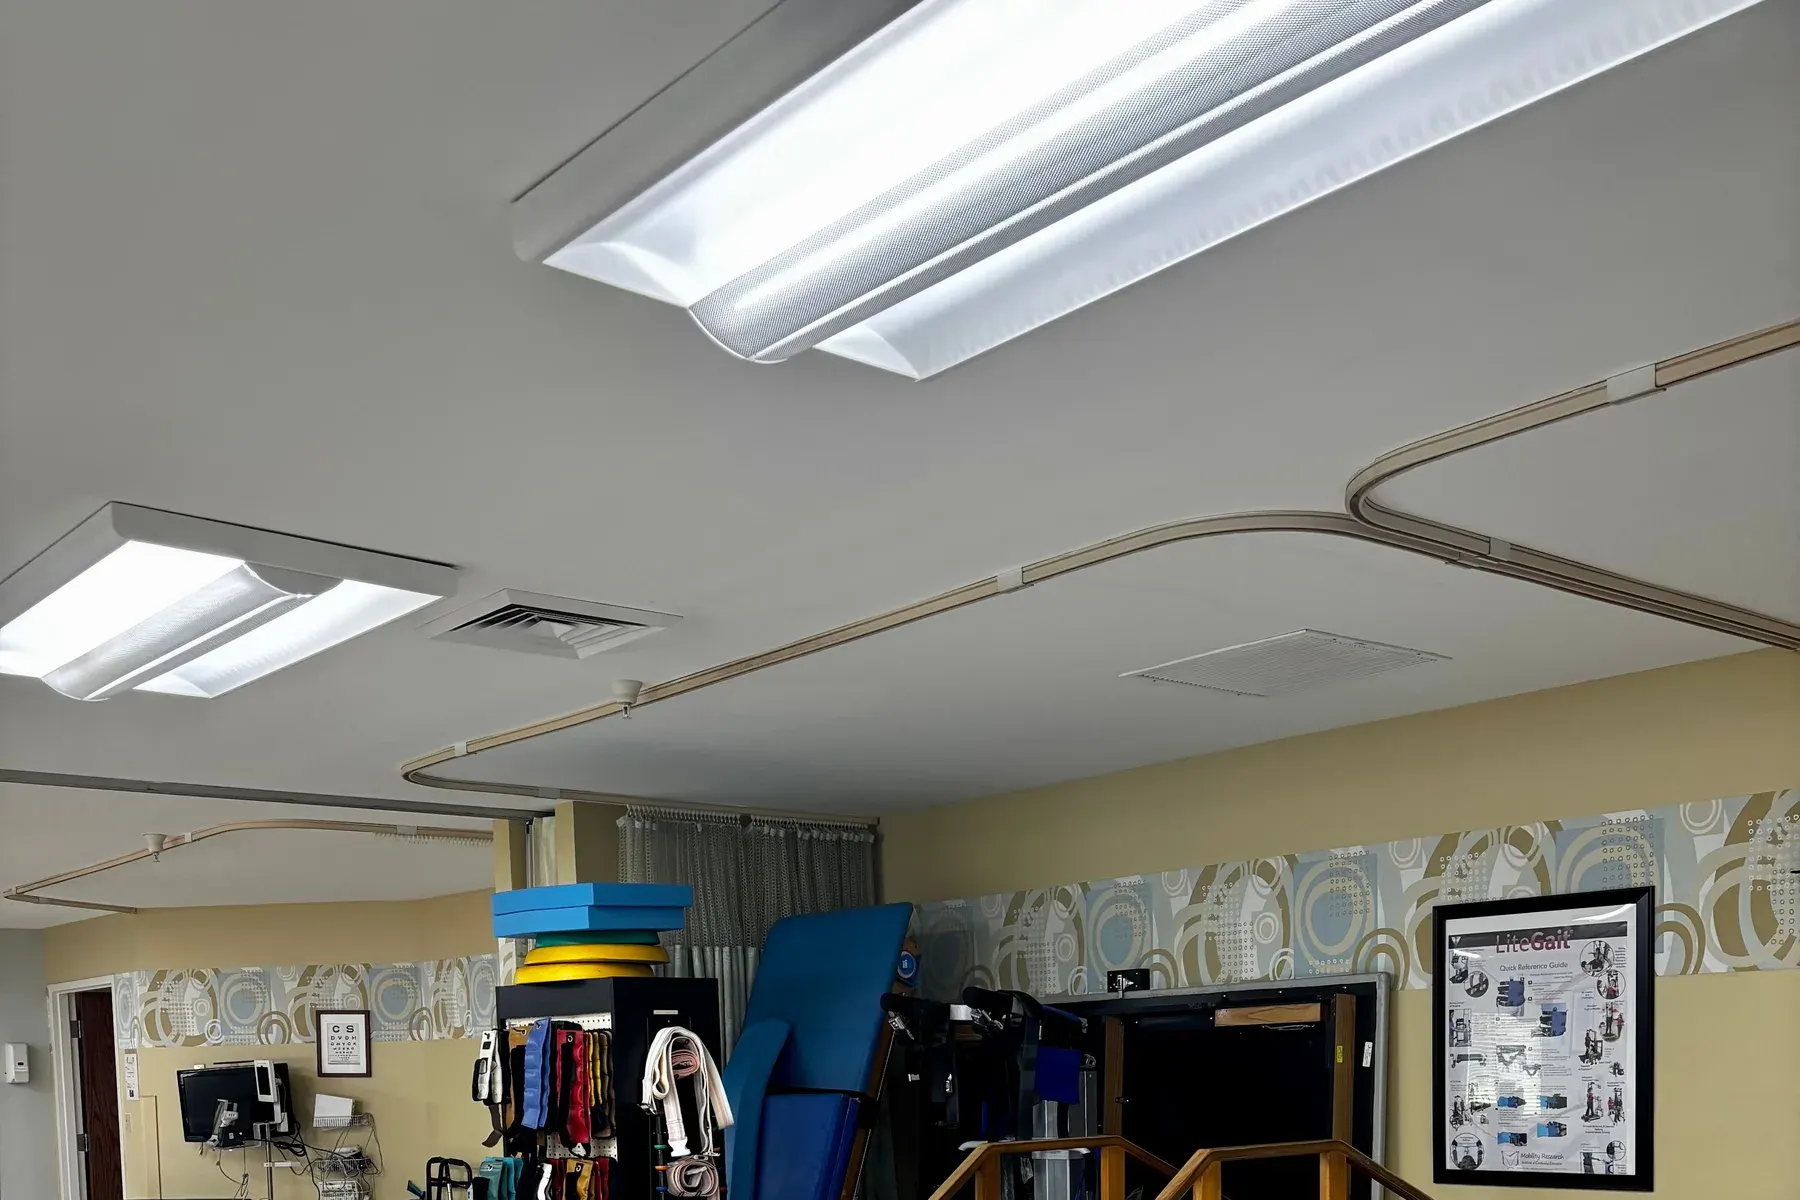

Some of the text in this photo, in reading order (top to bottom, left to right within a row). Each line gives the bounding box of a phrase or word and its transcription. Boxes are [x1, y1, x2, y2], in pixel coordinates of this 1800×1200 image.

[1500, 964, 1517, 972] Quick
[1518, 963, 1547, 971] Reference
[332, 1025, 354, 1033] C S
